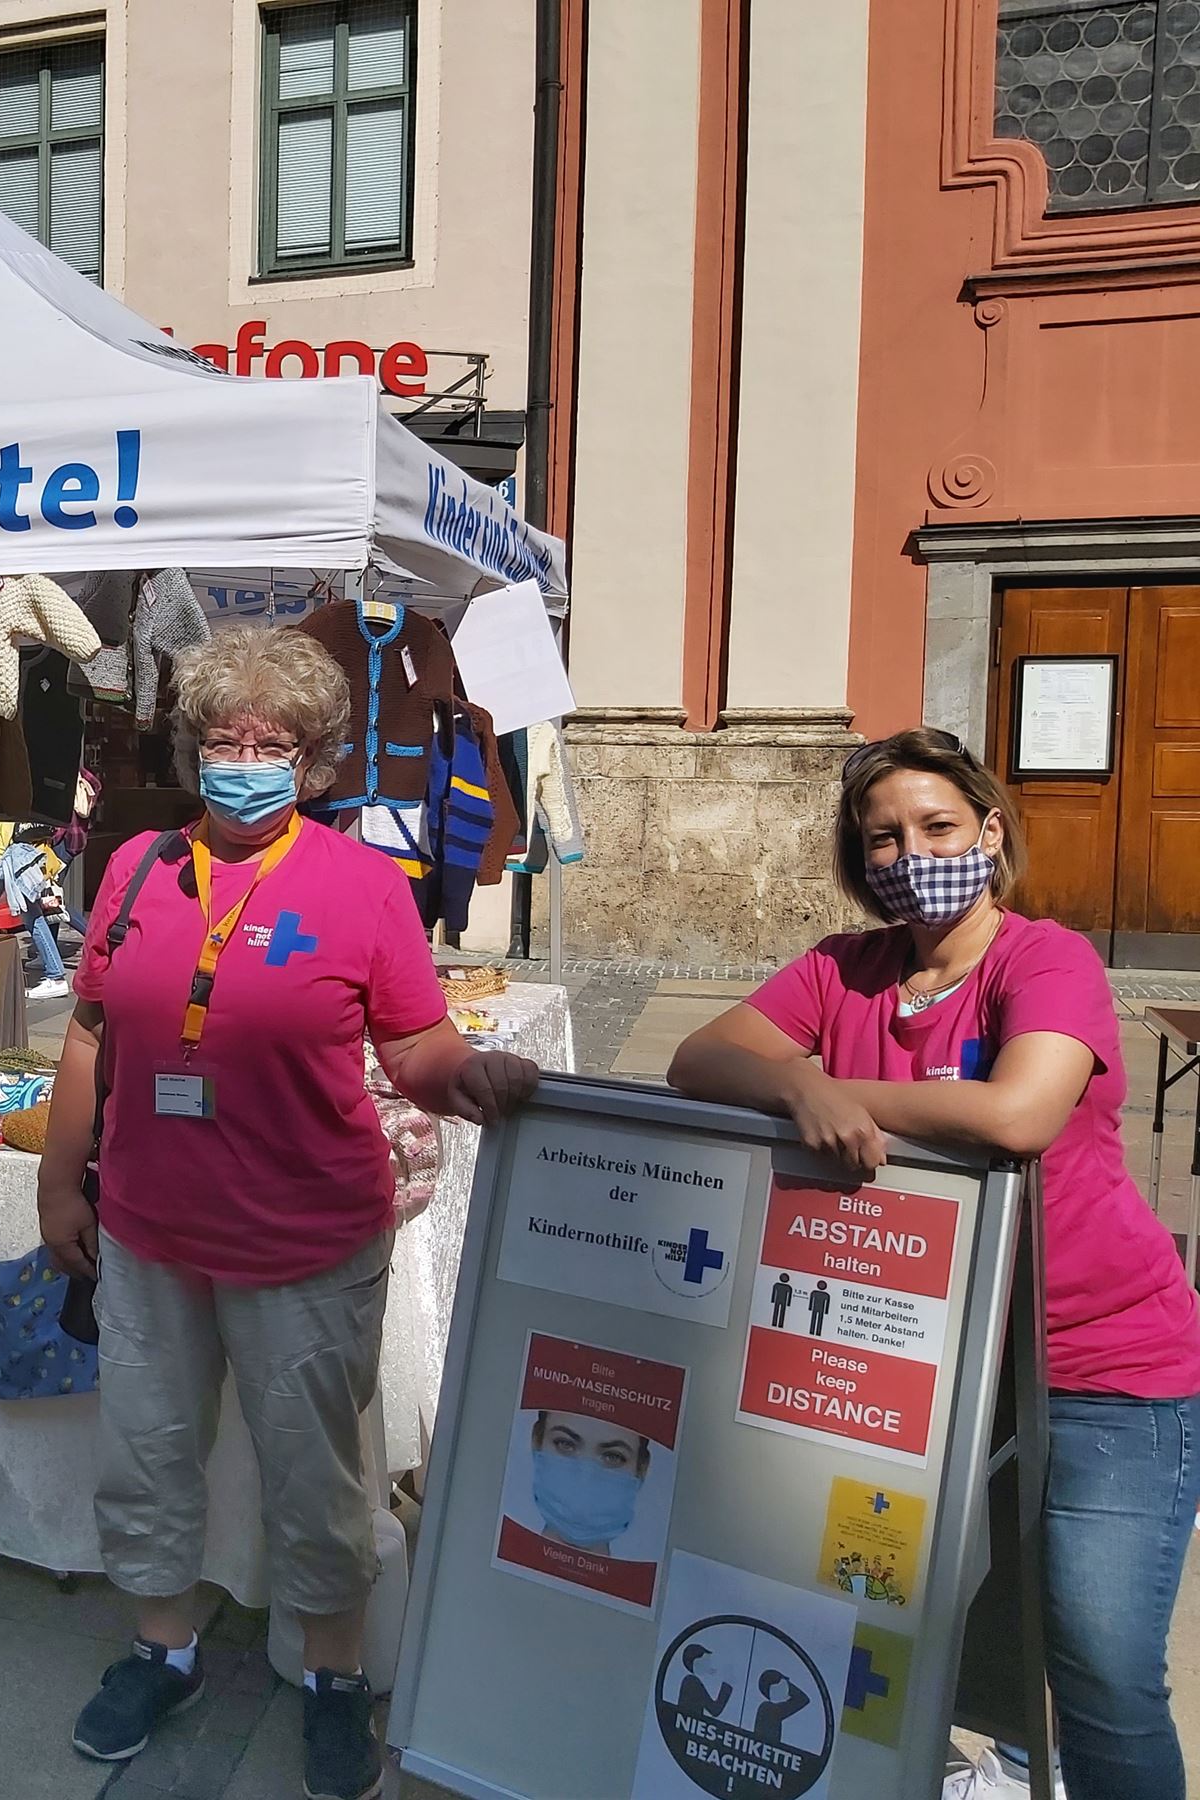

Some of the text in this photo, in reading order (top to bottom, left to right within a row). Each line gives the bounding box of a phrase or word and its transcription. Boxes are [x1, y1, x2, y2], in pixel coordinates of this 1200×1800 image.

[424, 462, 481, 561] Kinder
[243, 923, 274, 934] kinder
[255, 931, 272, 940] not
[247, 937, 270, 947] hilfe
[926, 1065, 960, 1077] kinder
[536, 1145, 724, 1190] Arbeitskreis München
[608, 1185, 638, 1203] der
[838, 1196, 883, 1218] Bitte
[527, 1216, 649, 1255] Kindernothilfe
[657, 1239, 688, 1251] KINDER
[787, 1214, 928, 1259] ABSTAND
[664, 1252, 688, 1264] HILFE
[670, 1248, 688, 1257] NOT
[822, 1252, 882, 1277] halten
[842, 1288, 915, 1311] Bitte zur Kasse
[840, 1302, 919, 1325] und Mitarbeitern
[837, 1326, 905, 1349] halten. Danke!
[839, 1314, 925, 1339] 1,5 Meter Abstand
[591, 1361, 616, 1379] Bitte
[811, 1348, 869, 1374] Please
[533, 1365, 672, 1412] MUND-/NASENSCHUTZ
[815, 1370, 857, 1395] keep
[581, 1395, 615, 1414] tragen
[767, 1382, 902, 1434] DISTANCE
[543, 1545, 575, 1566] Vielen
[577, 1555, 609, 1576] Dank!
[674, 1712, 802, 1773] NIES-ETIKETTE
[685, 1738, 784, 1790] BEACHTEN
[726, 1776, 734, 1793] !
